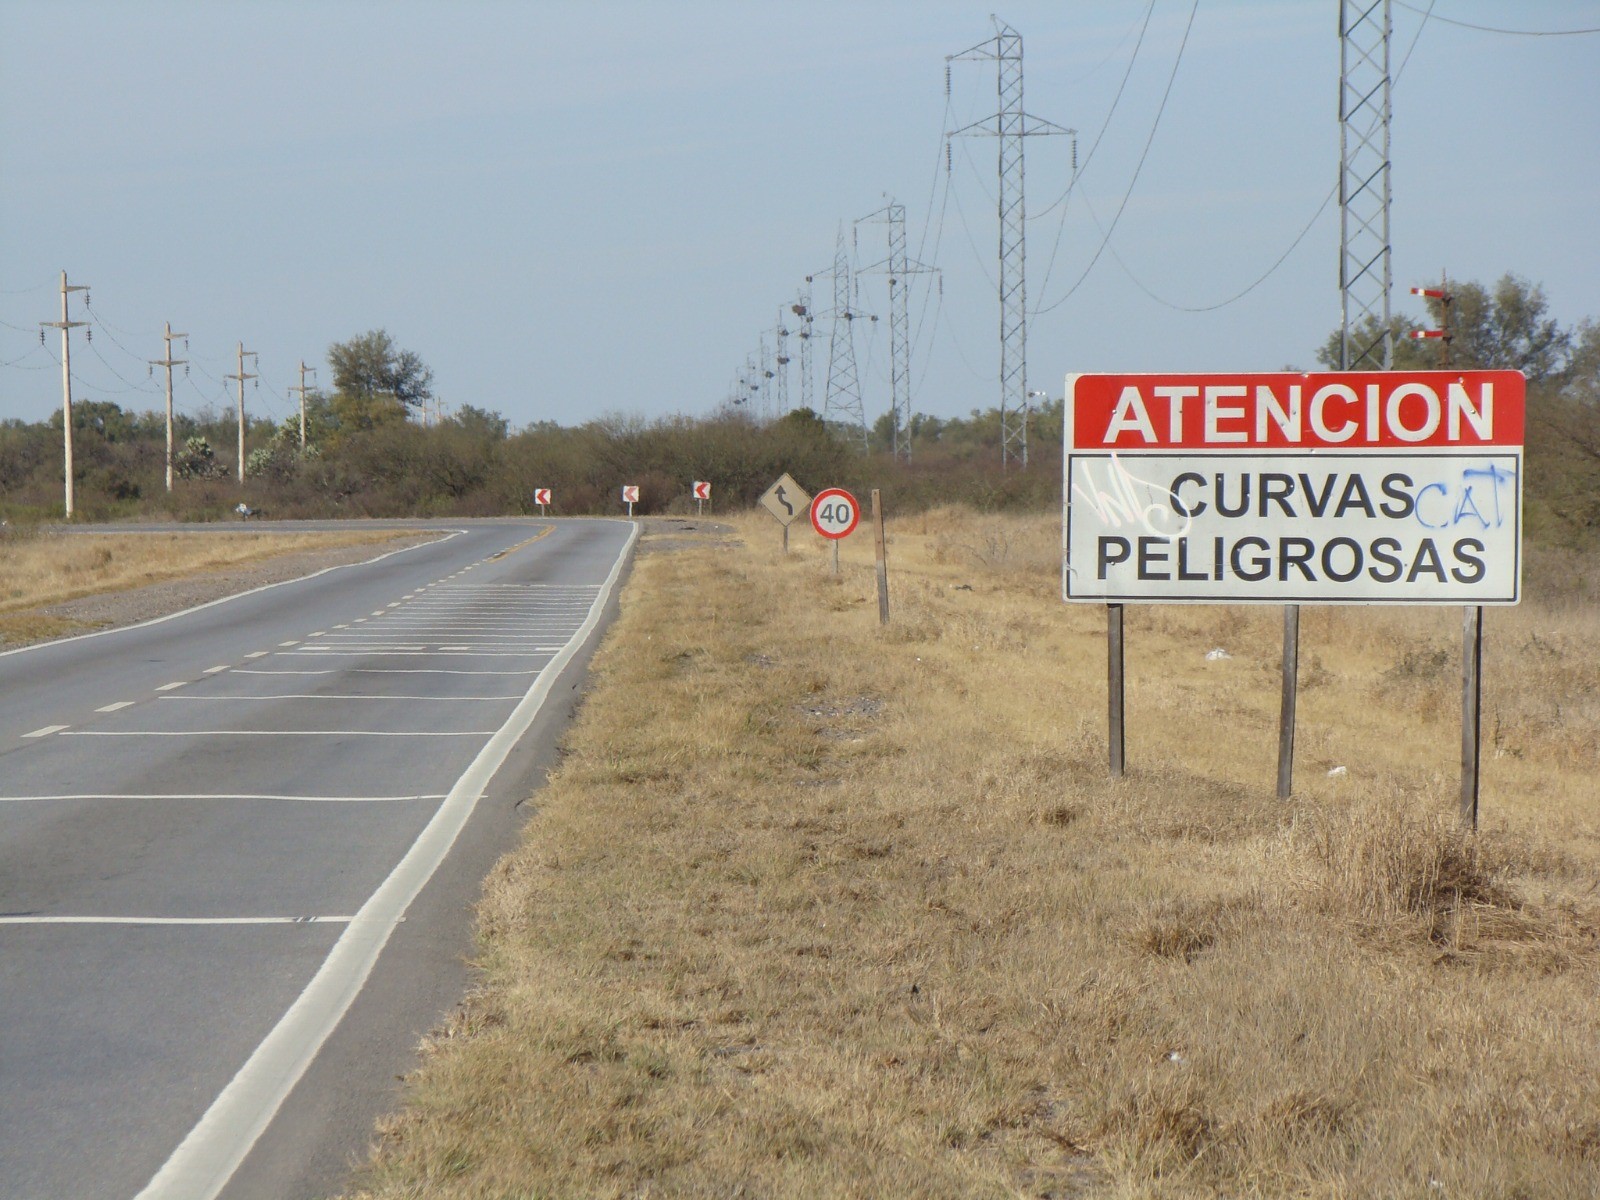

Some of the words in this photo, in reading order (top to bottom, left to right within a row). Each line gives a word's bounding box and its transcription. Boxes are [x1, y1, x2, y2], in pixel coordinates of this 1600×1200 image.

[1102, 382, 1494, 444] ATENCION
[820, 503, 850, 523] 40
[1170, 472, 1415, 519] CURVAS
[1096, 535, 1487, 584] PELIGROSAS
